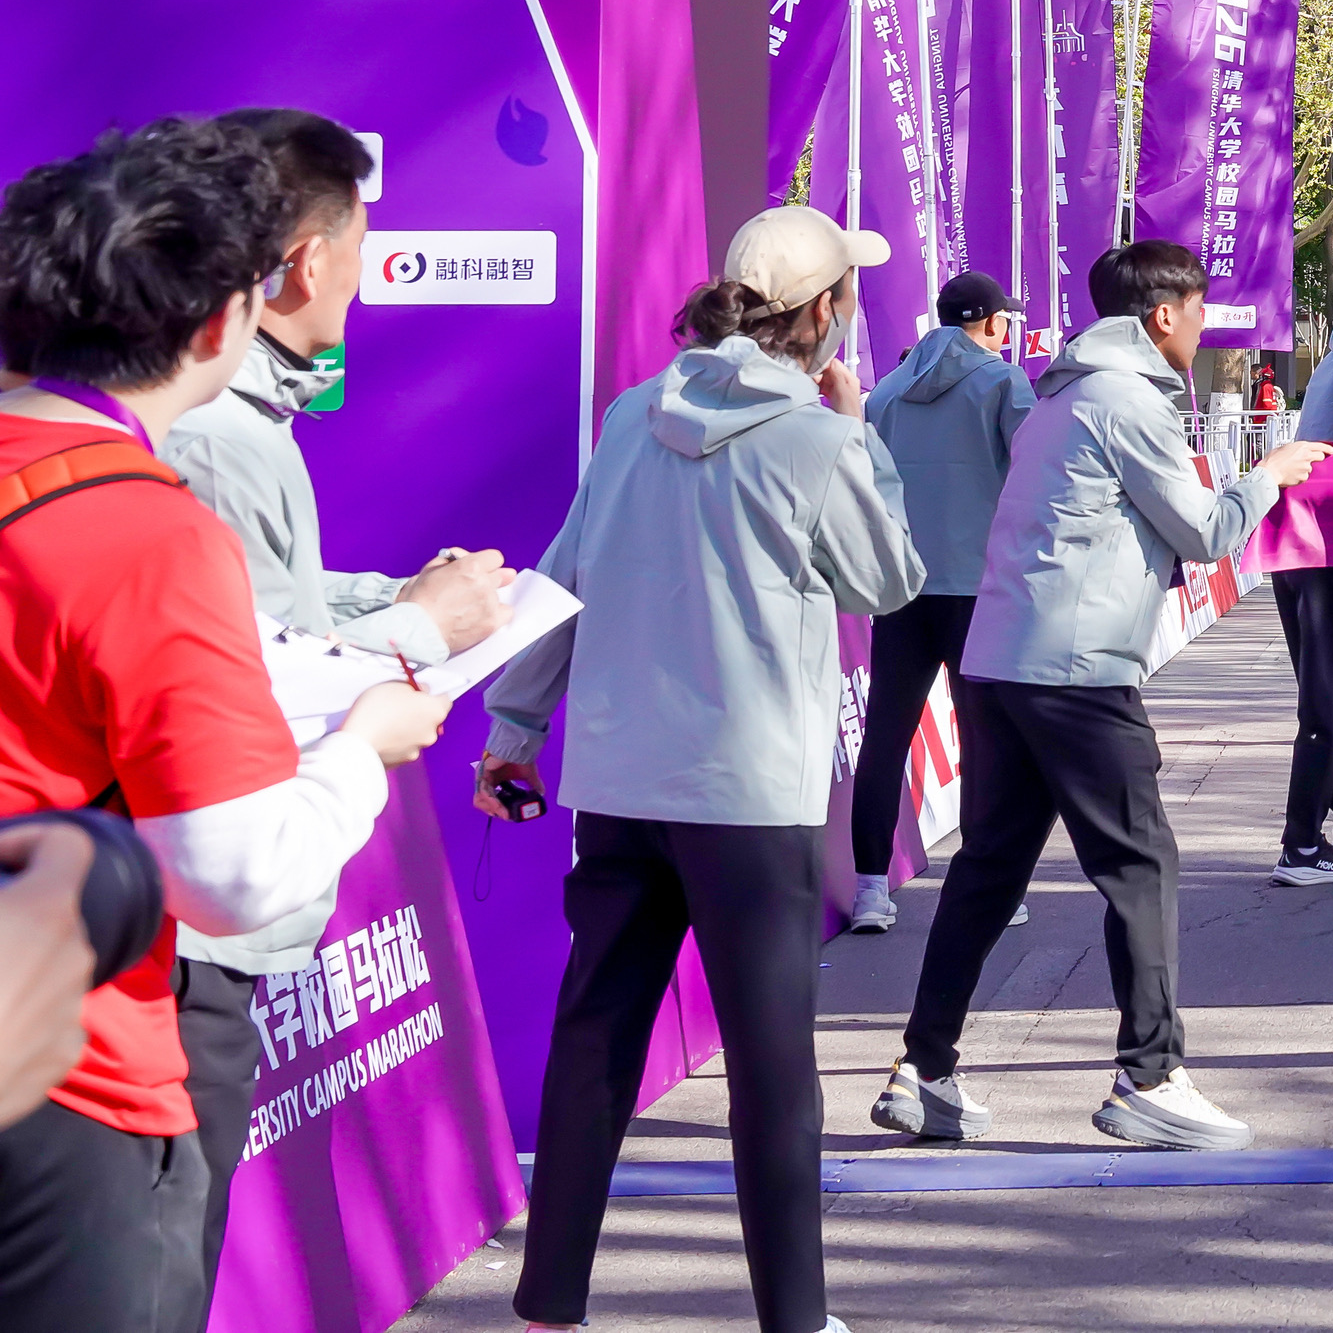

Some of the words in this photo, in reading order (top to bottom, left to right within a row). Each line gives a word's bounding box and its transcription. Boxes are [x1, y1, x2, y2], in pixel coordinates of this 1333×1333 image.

[1210, 67, 1220, 117] TSINGHUA
[1206, 122, 1216, 177] UNIVERSITY
[1209, 69, 1244, 278] 清华大学校园马拉松
[1203, 179, 1213, 221] CAMPUS
[435, 258, 533, 281] 融科融智
[243, 1085, 301, 1161] ERSITY
[303, 1048, 367, 1118] CAMPUS
[366, 1002, 443, 1082] MARATHON
